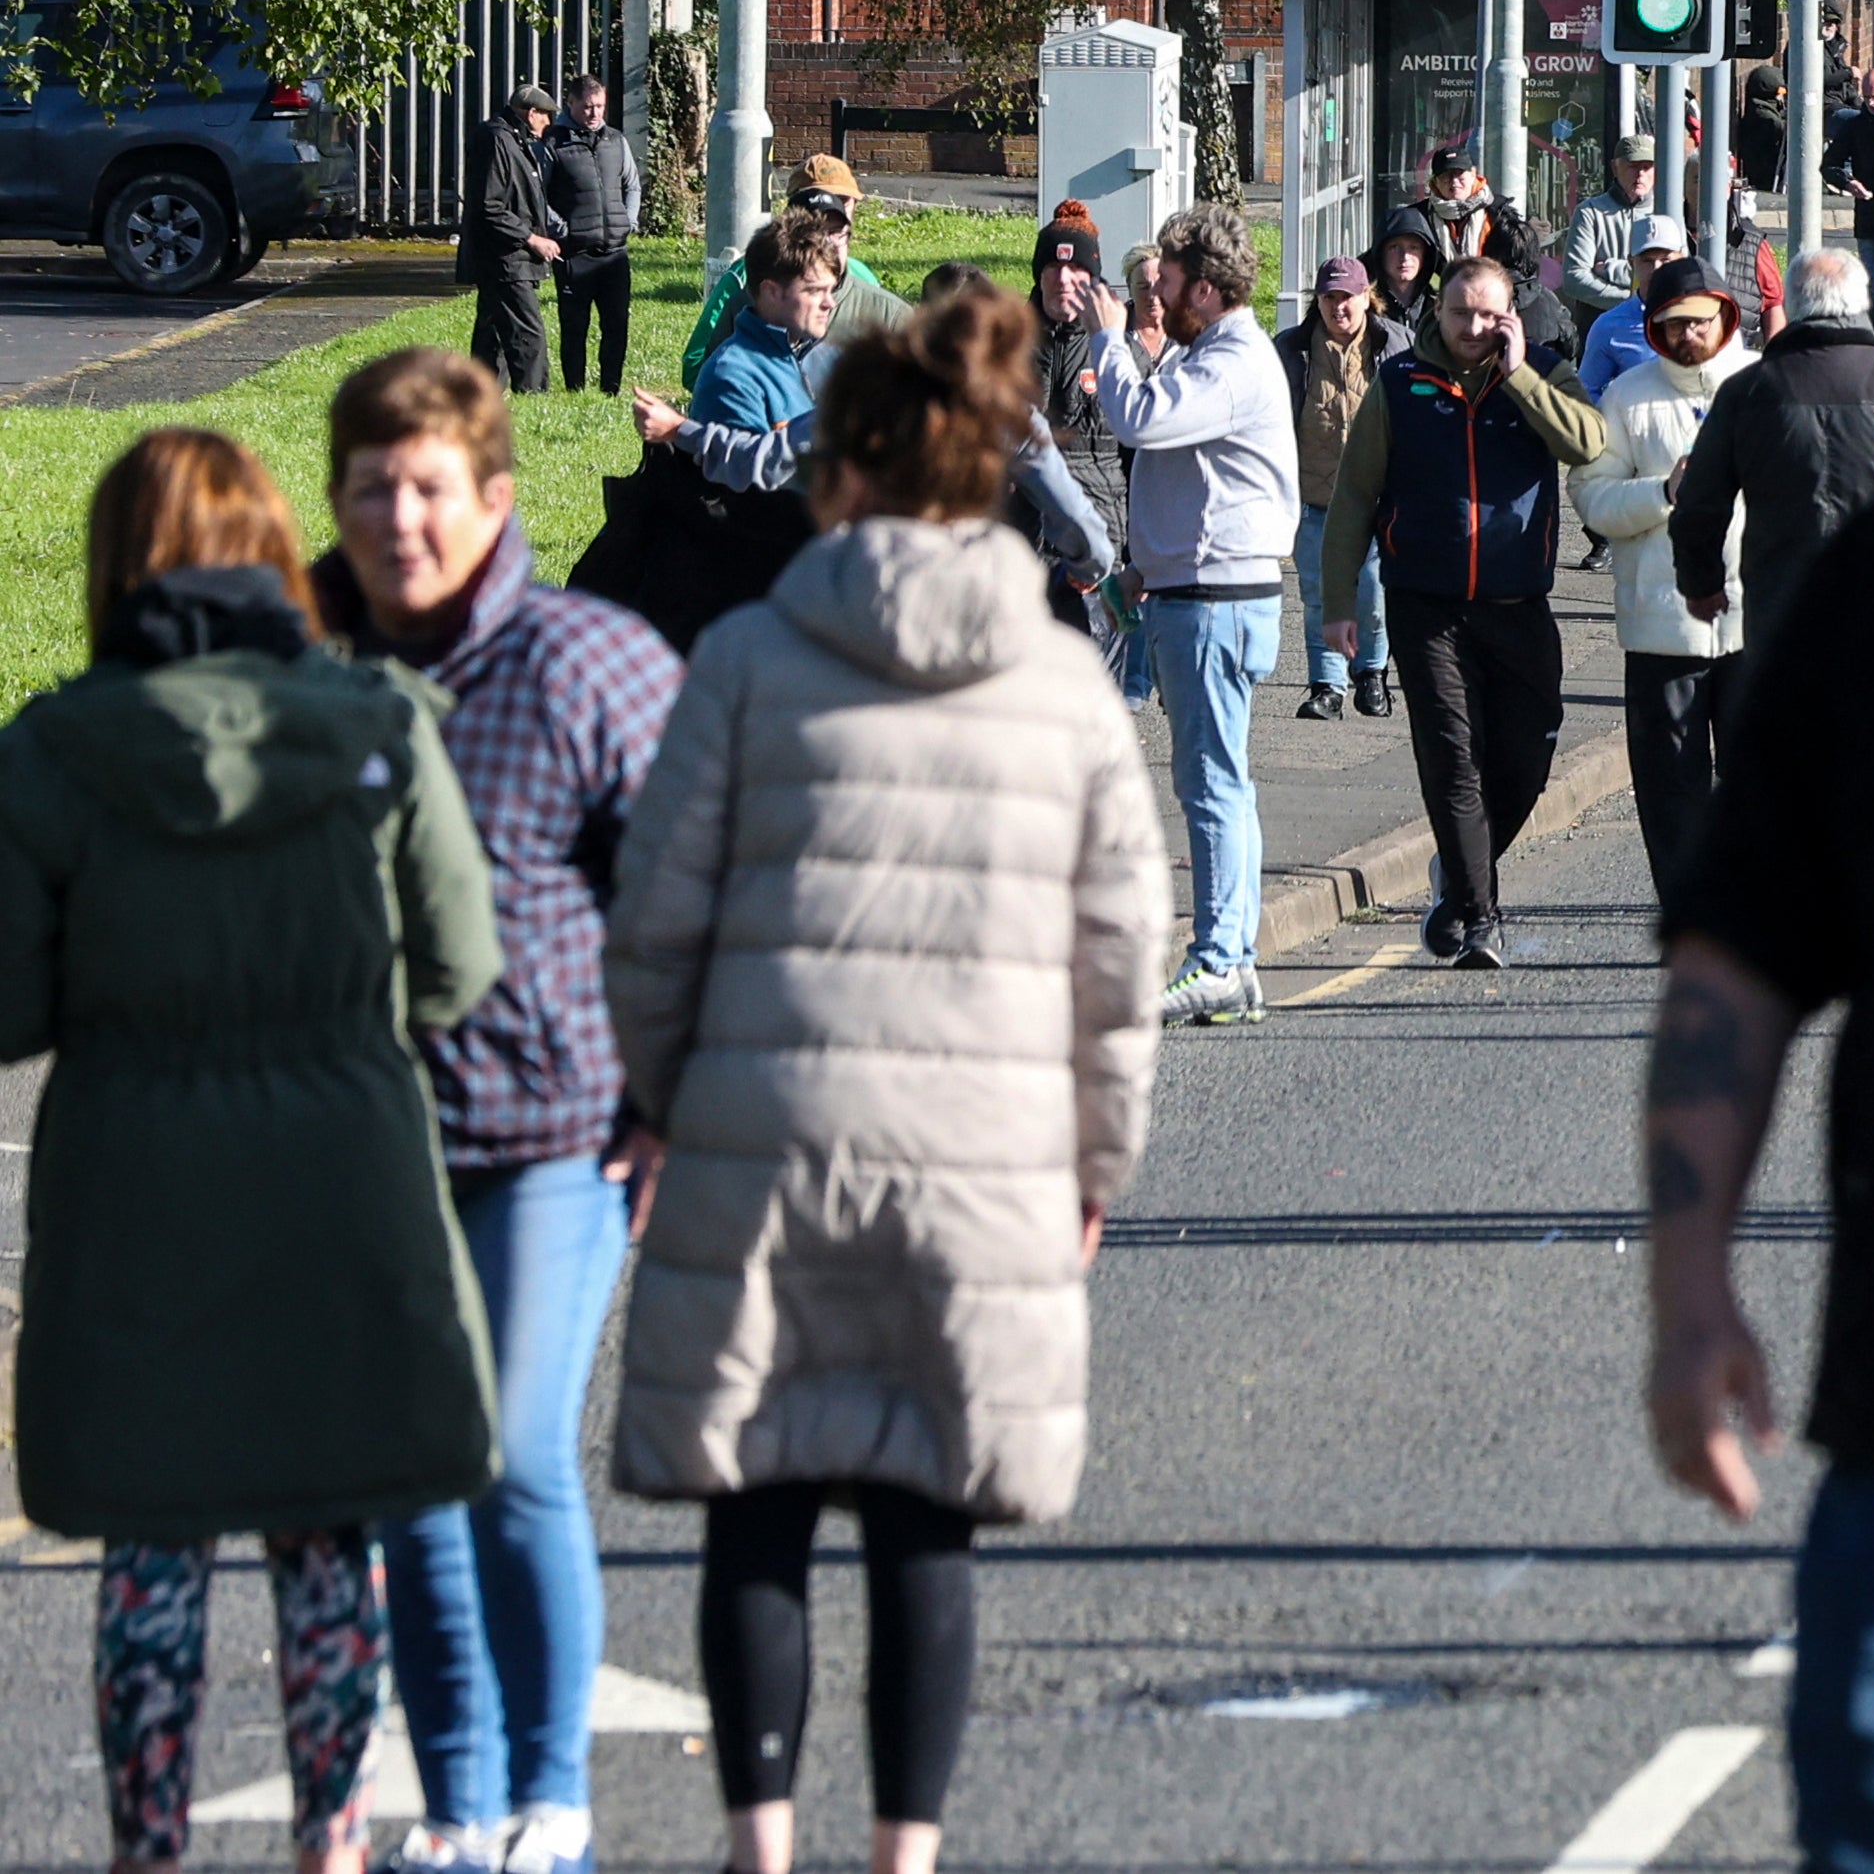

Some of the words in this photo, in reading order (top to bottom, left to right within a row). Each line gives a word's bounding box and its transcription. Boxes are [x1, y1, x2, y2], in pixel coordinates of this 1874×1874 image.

[1400, 54, 1478, 72] AMBITI
[1534, 55, 1595, 72] GROW
[1441, 77, 1474, 87] Receive
[1537, 78, 1554, 87] and
[1433, 88, 1468, 98] support
[1528, 89, 1561, 98] usiness
